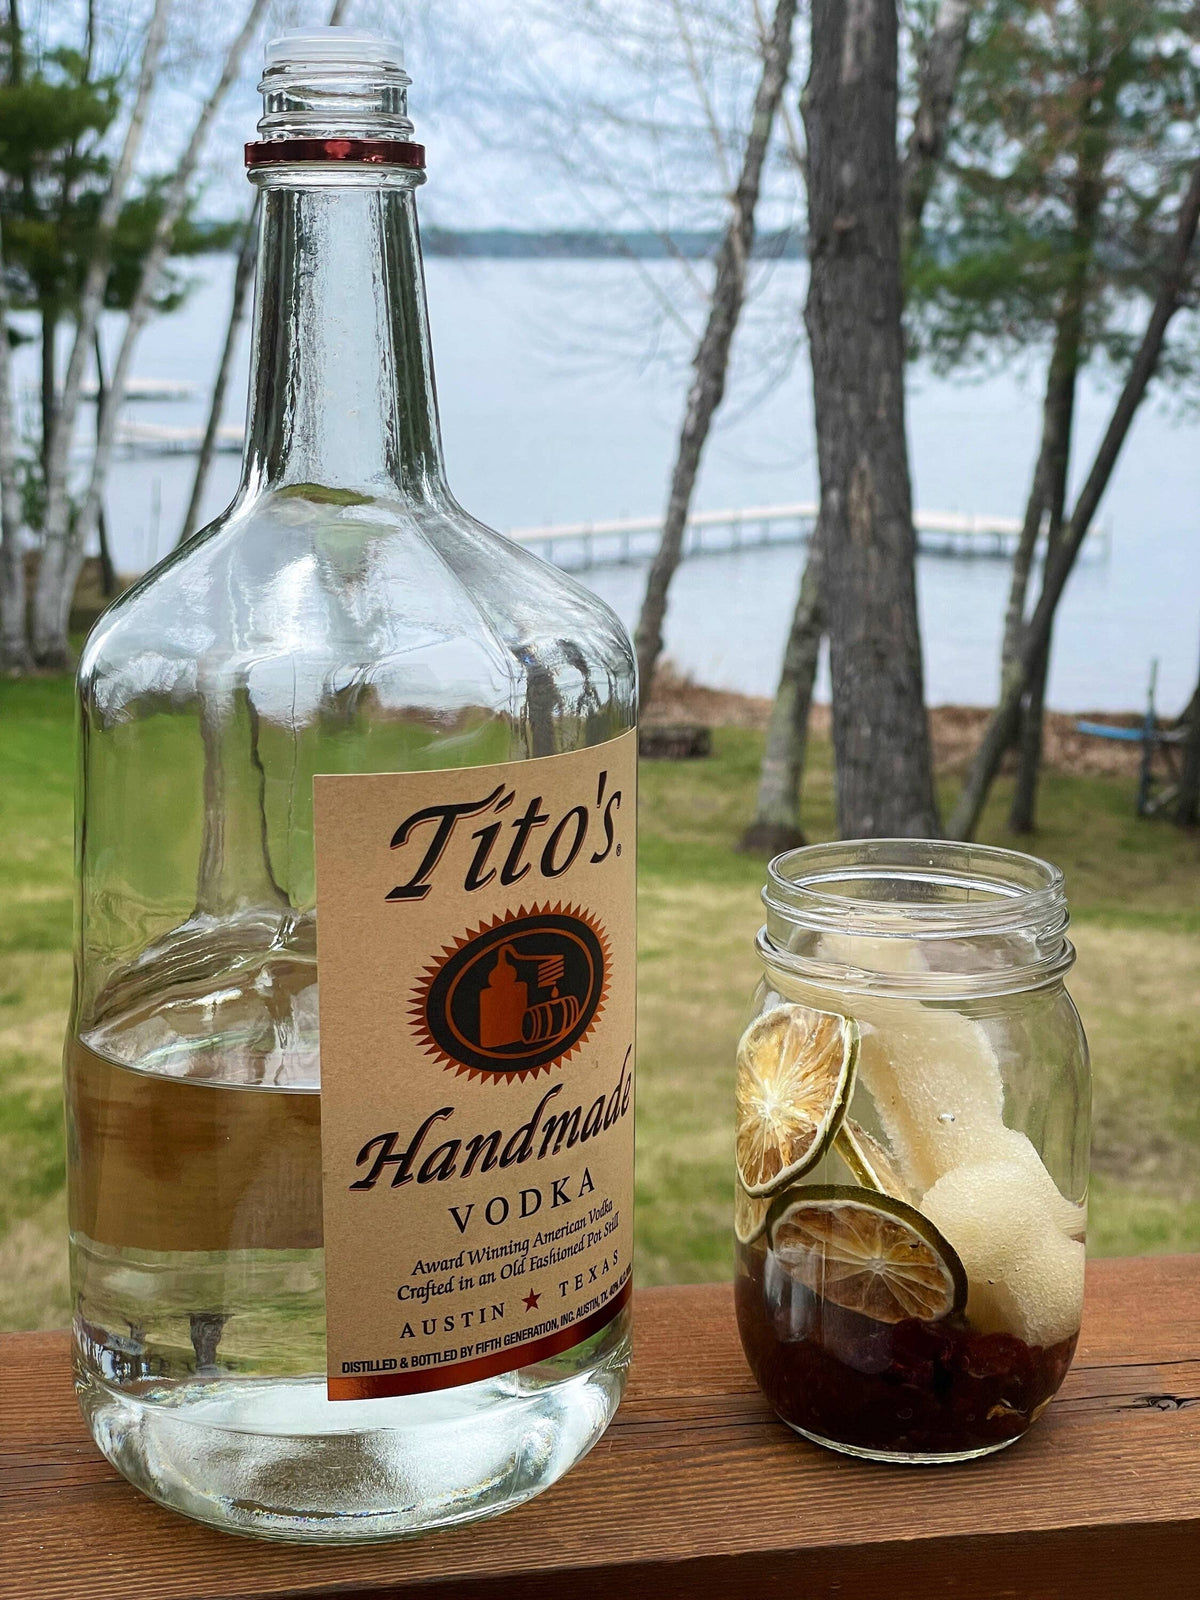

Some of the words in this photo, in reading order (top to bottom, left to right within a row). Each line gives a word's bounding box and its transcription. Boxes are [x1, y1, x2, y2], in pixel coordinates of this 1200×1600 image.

[384, 770, 622, 902] Tito's
[349, 1043, 632, 1192] Handmade
[411, 1250, 465, 1275] Award
[467, 1239, 530, 1264] Winning
[532, 1220, 587, 1248] American
[588, 1198, 614, 1223] Vodka
[448, 1168, 595, 1234] VODKA
[397, 1276, 455, 1304] Crafted
[459, 1276, 474, 1291] in
[478, 1272, 497, 1286] an
[500, 1257, 526, 1280] Old
[529, 1233, 585, 1272] Fashioned
[586, 1228, 602, 1248] Pot
[603, 1211, 620, 1238] Still
[400, 1302, 505, 1339] AUSTIN
[558, 1249, 618, 1298] TEXAS
[341, 1358, 397, 1374] DISTILLED
[399, 1357, 409, 1369] &
[411, 1349, 458, 1367] BOTTLED
[460, 1345, 475, 1358] BY
[475, 1337, 502, 1355] FIFTH
[503, 1318, 560, 1347] GENERATION,
[560, 1310, 576, 1327] INC.
[576, 1296, 601, 1319] AUSTIN,
